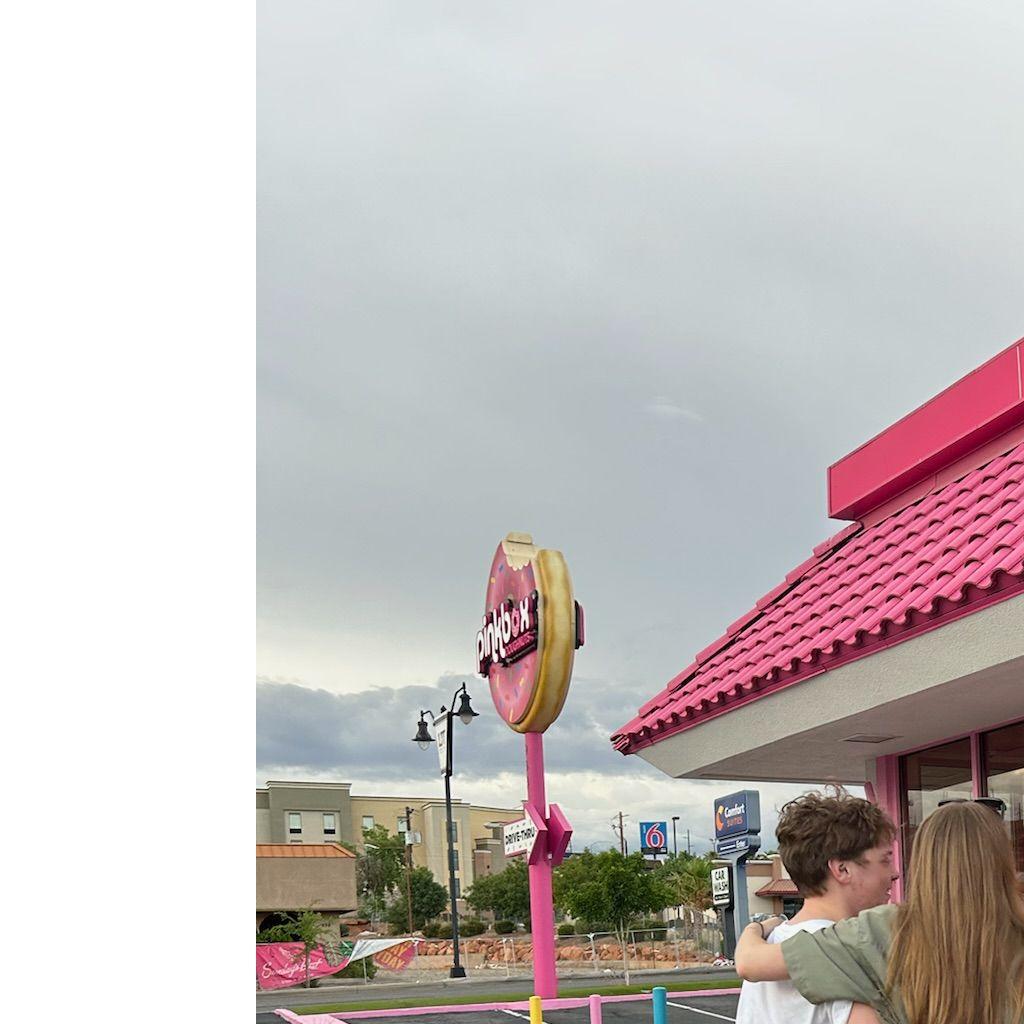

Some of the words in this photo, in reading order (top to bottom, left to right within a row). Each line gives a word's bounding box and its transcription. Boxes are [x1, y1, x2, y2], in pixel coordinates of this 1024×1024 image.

[476, 596, 530, 673] pinkbox
[724, 803, 745, 818] Comfort
[505, 826, 535, 845] DRIVE-THRU
[646, 823, 665, 848] 6
[714, 870, 725, 880] CAR
